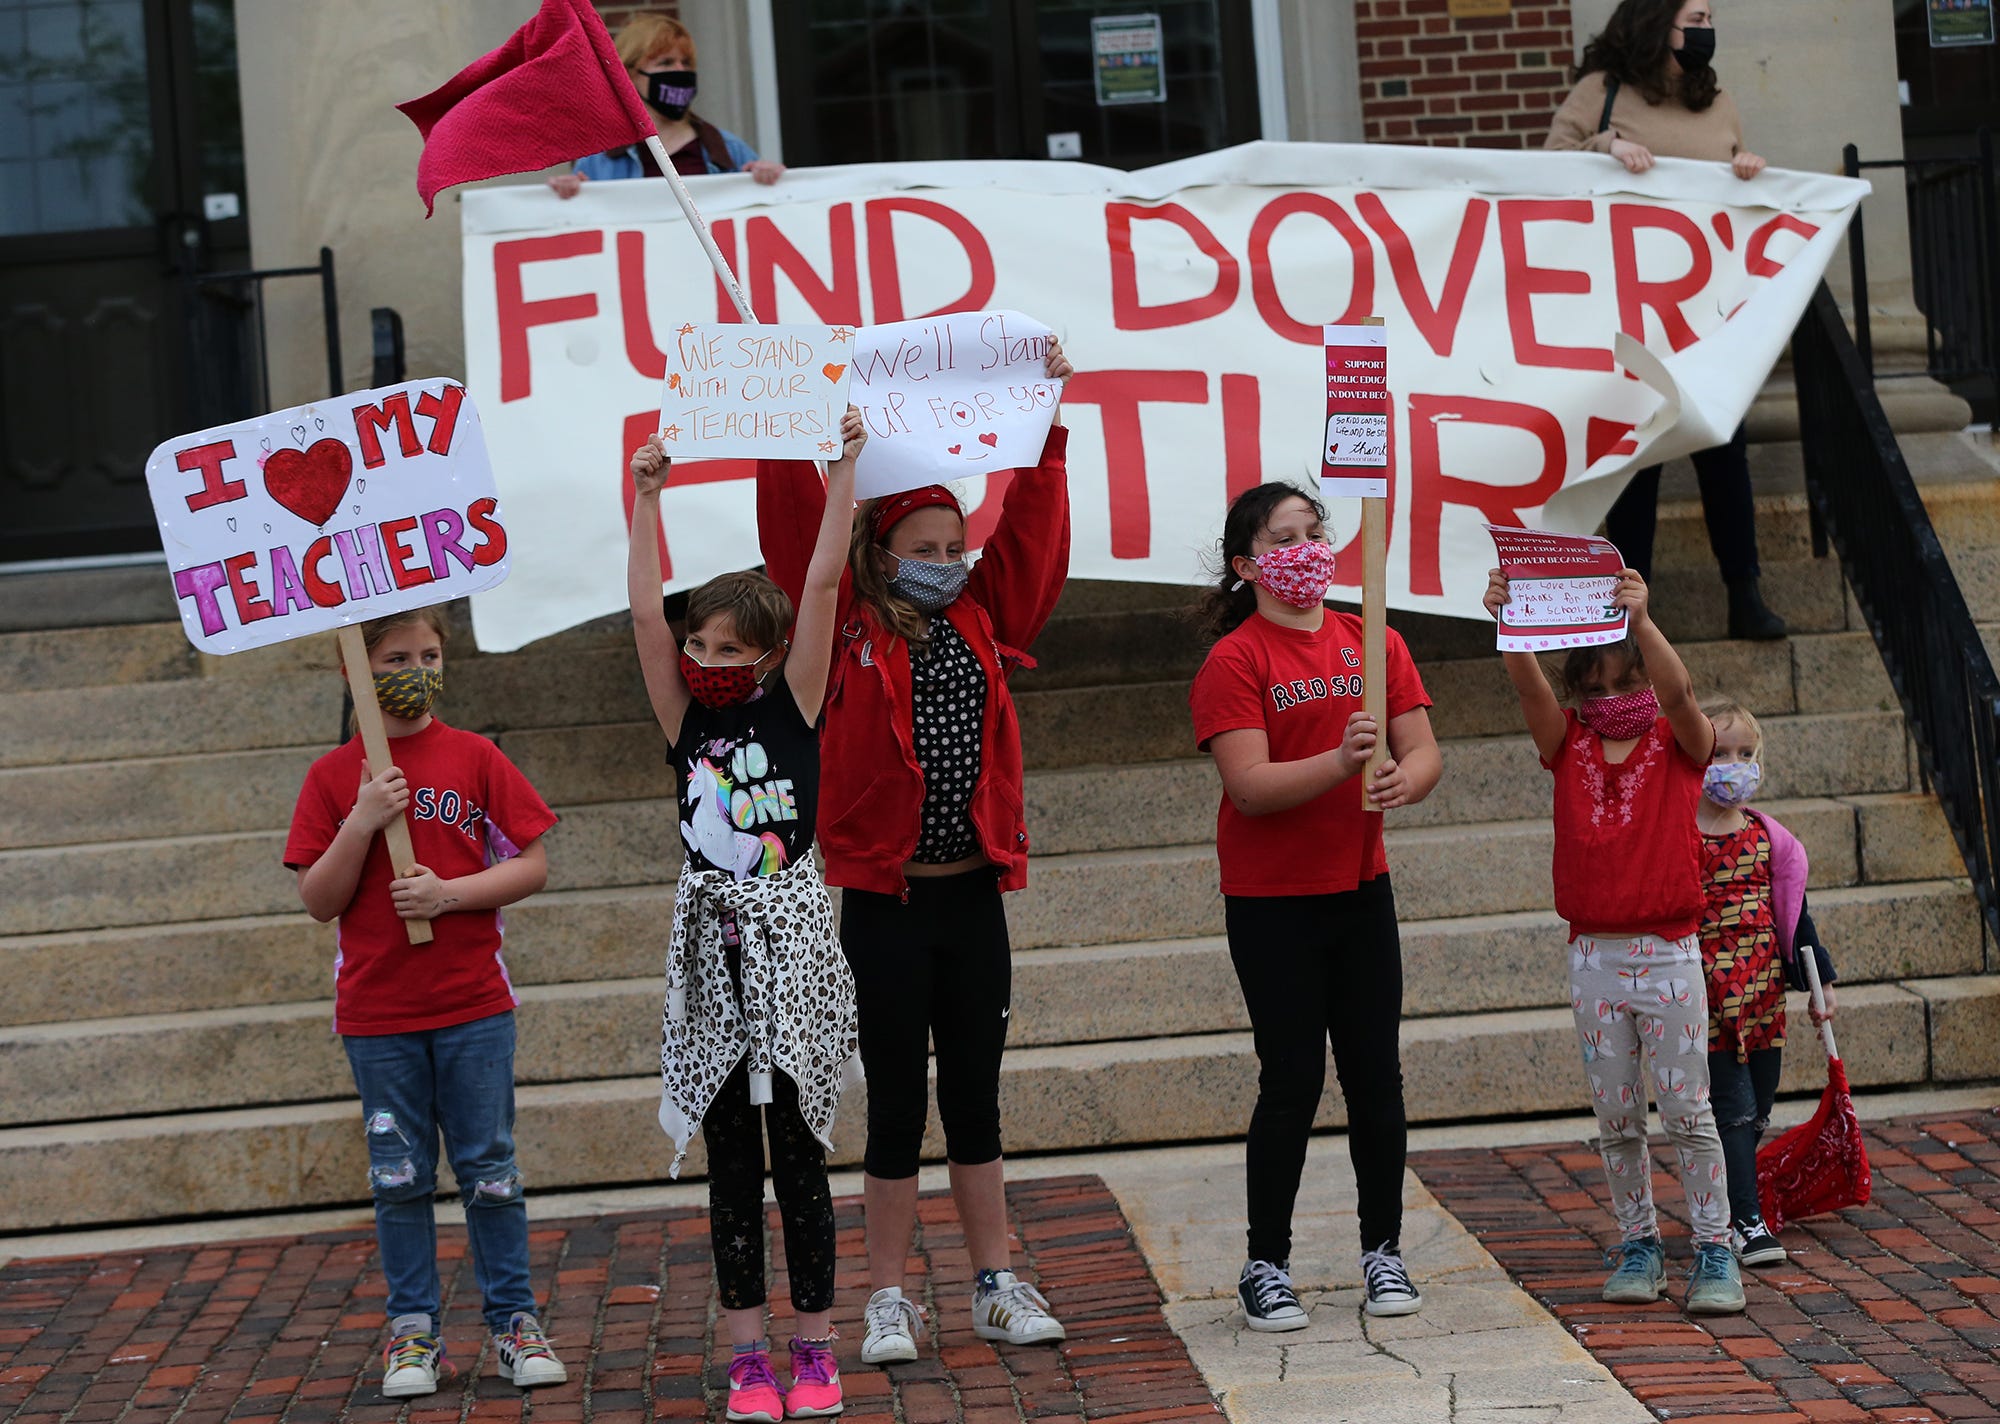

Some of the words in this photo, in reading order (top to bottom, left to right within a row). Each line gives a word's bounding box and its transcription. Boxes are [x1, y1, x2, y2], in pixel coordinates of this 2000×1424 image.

[494, 197, 996, 403] FUND
[678, 332, 724, 373] WE
[730, 336, 814, 369] STAND
[852, 323, 955, 386] We'll
[980, 314, 1051, 371] Stan
[1344, 360, 1385, 369] SUPPORT
[677, 373, 727, 399] WITH
[742, 374, 811, 401] OUR
[1328, 375, 1359, 384] PUBLIC
[1328, 390, 1338, 398] IN
[1338, 390, 1368, 399] DOVER
[682, 401, 832, 441] TEACHERS!
[928, 391, 1004, 429] FOR
[175, 440, 248, 513] I
[352, 385, 466, 470] MY
[174, 497, 507, 637] TEACHERS
[1501, 558, 1512, 566] IN
[1513, 557, 1546, 565] DOVER
[1341, 647, 1360, 668] C
[1271, 678, 1328, 712] RED
[1331, 674, 1364, 698] SO
[414, 787, 483, 841] SOX
[730, 778, 799, 830] ONE
